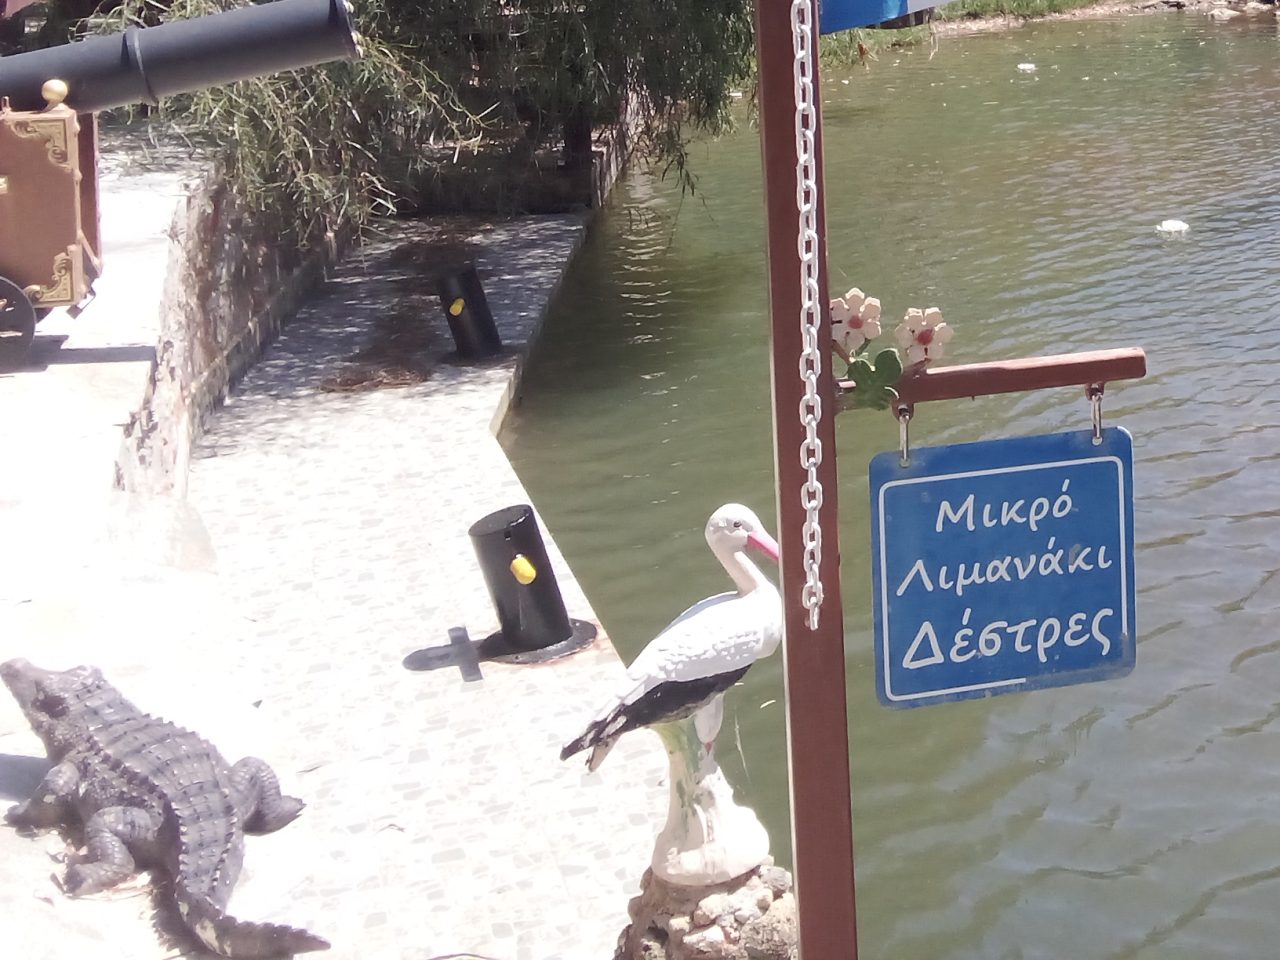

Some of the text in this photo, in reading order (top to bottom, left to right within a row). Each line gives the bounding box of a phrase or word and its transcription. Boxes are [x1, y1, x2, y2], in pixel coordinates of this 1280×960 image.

[935, 479, 1073, 533] Μικρό
[896, 537, 1112, 596] Λιμανάκι
[902, 607, 1113, 669] Δέστρες
